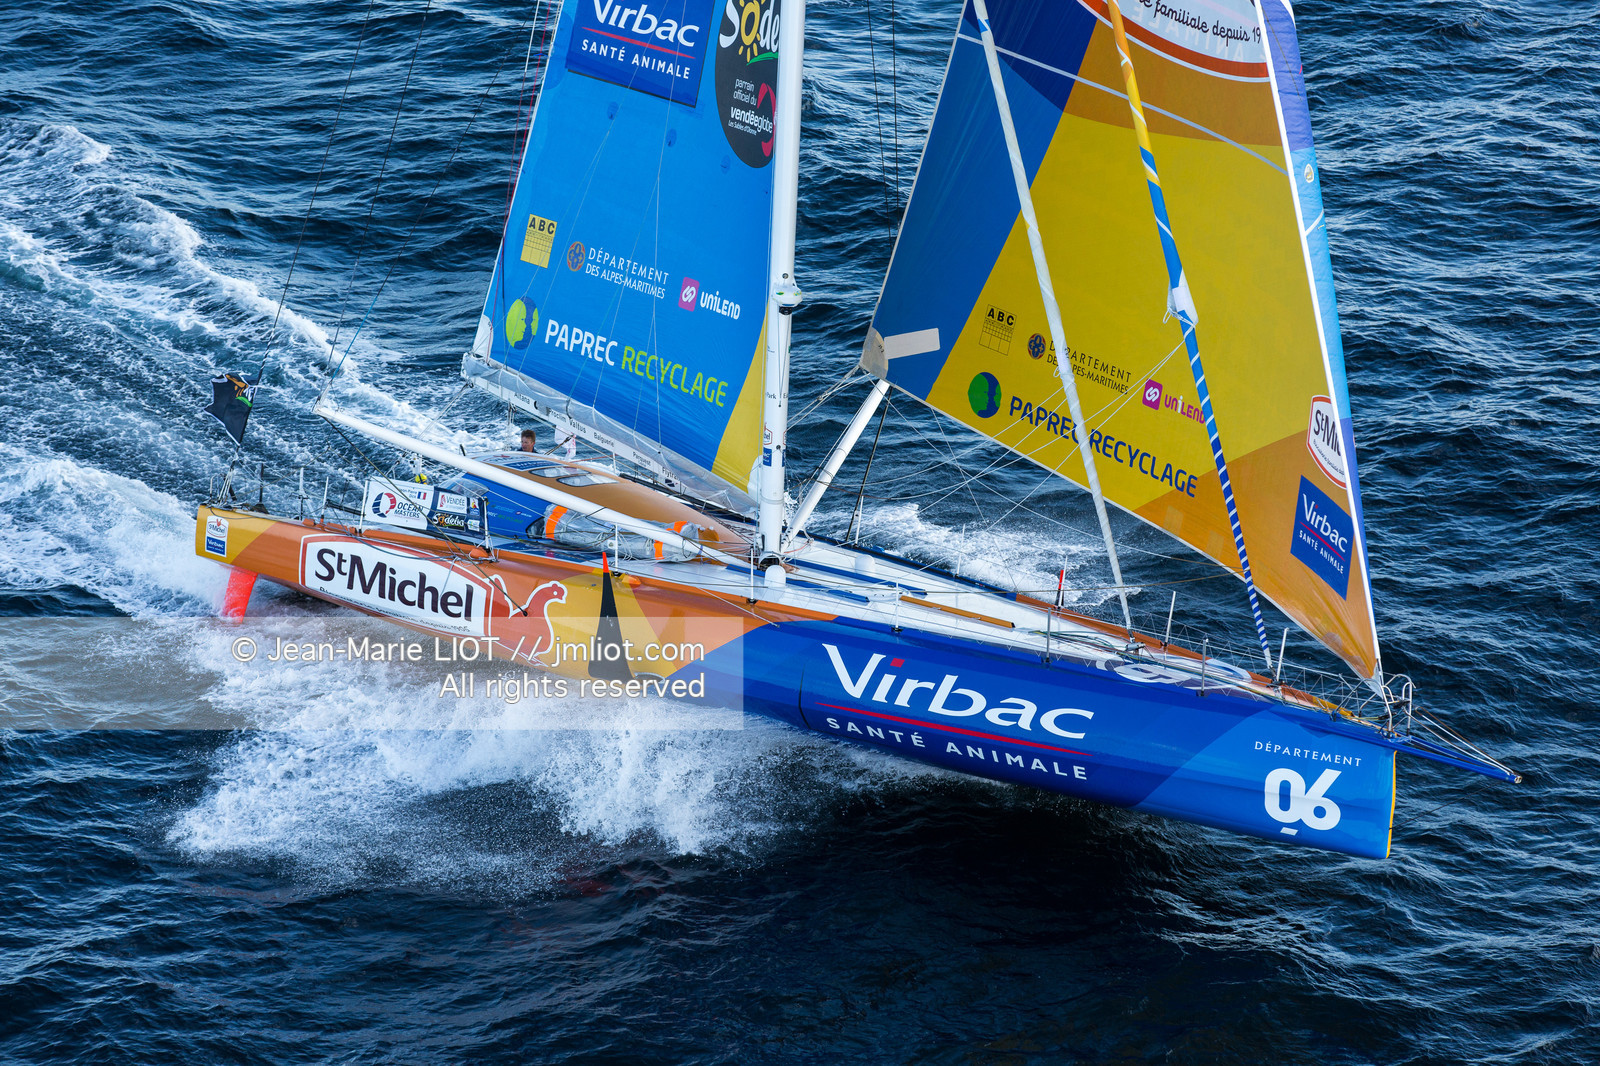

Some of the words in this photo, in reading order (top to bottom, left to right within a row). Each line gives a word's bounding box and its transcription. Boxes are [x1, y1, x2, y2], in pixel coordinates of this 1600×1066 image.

[593, 0, 700, 47] Virbac
[1153, 0, 1209, 33] familiale
[1212, 20, 1250, 47] depuis
[581, 39, 626, 62] SANTÉ
[631, 53, 691, 79] ANIMALE
[733, 89, 750, 103] officiel
[750, 95, 757, 106] du
[735, 79, 754, 92] parrain
[585, 263, 600, 277] DES
[600, 269, 666, 299] ALPES-MARITIMES
[588, 247, 669, 285] DÉPARTEMENT
[544, 319, 618, 366] PAPREC
[621, 345, 729, 408] RECYCLAGE
[1089, 428, 1198, 498] RECYCLAGE
[394, 509, 420, 519] MASTERS
[397, 501, 424, 513] OCEAN
[432, 513, 465, 527] Sodebo
[1303, 493, 1348, 554] Virbac
[1299, 530, 1319, 551] SANTÉ
[1320, 546, 1345, 575] ANIMALE
[822, 643, 1094, 739] Virbac
[826, 717, 926, 748] SANTÉ
[946, 741, 1088, 780] ANIMALE
[1254, 740, 1362, 767] DÉPARTEMENT
[1264, 767, 1342, 831] 06
